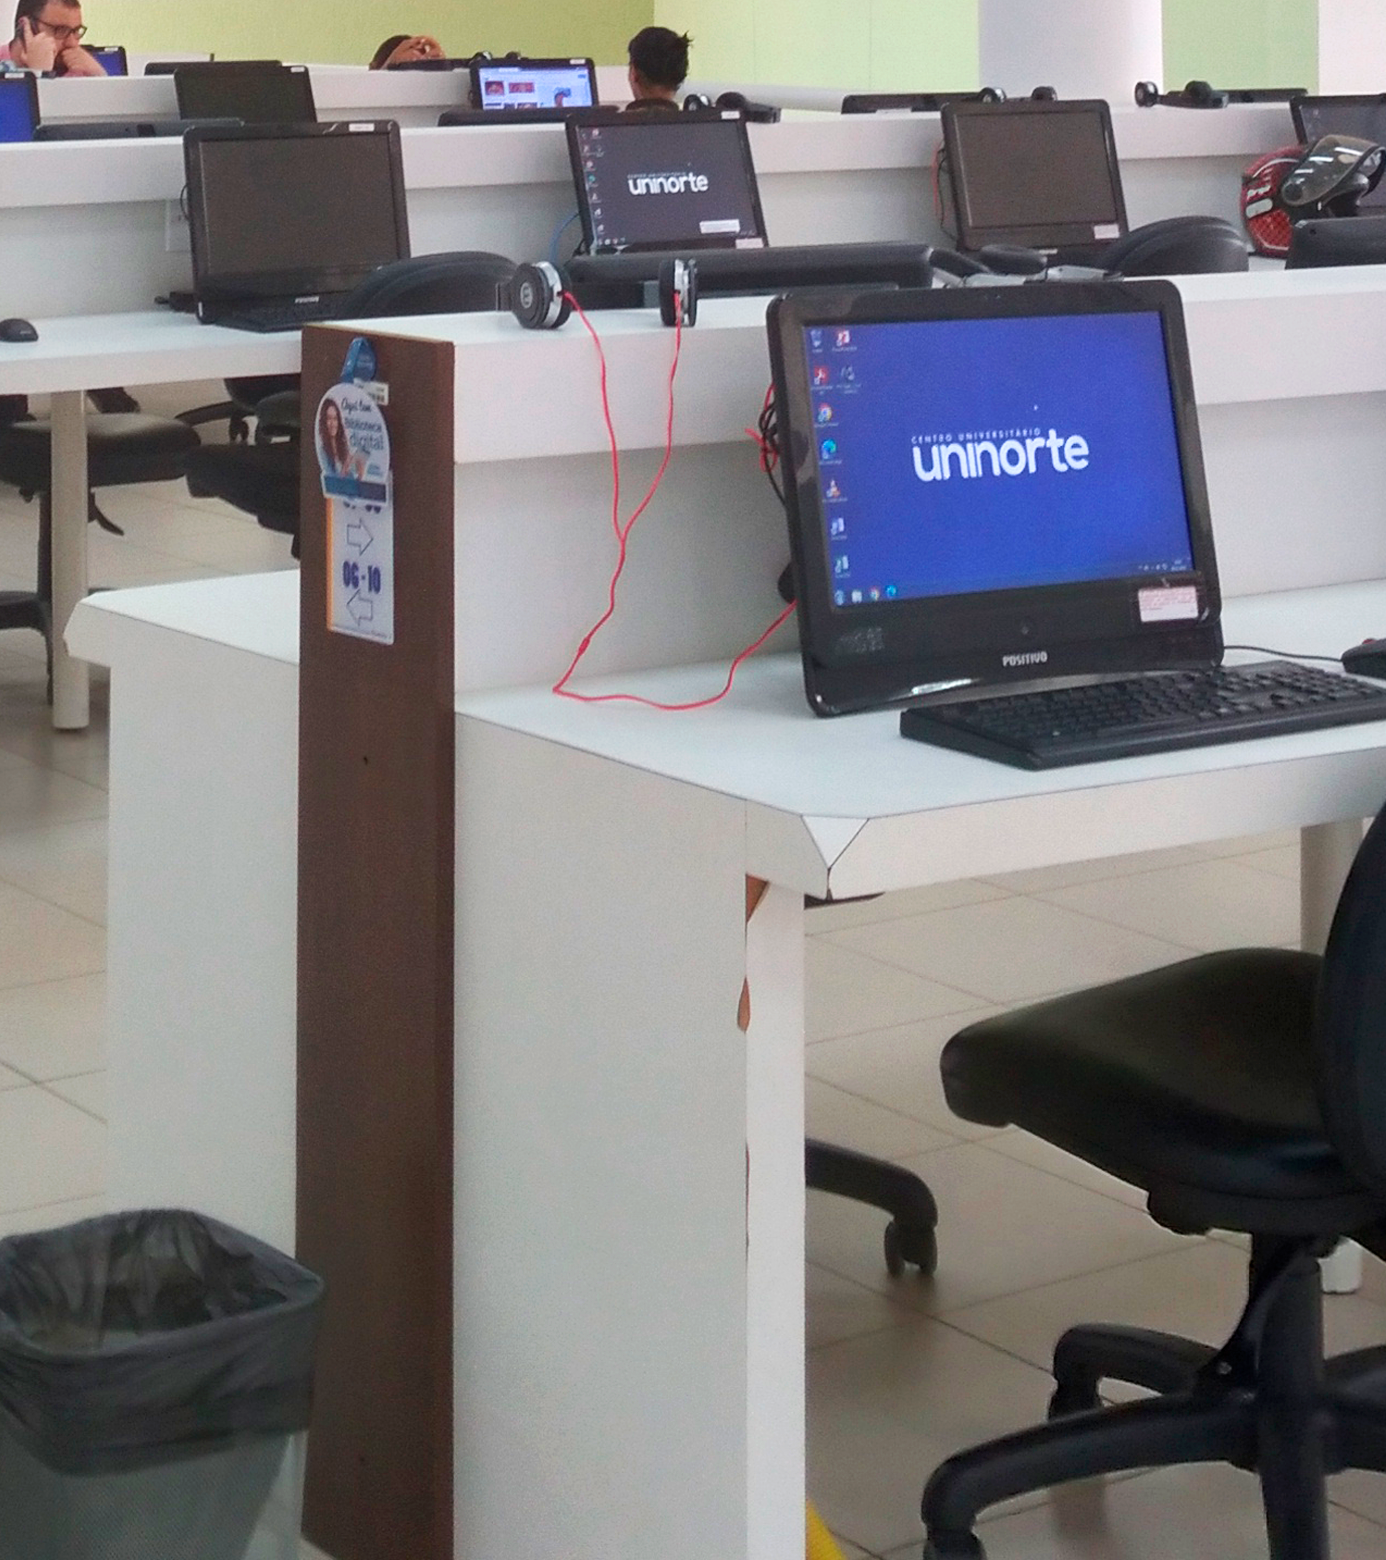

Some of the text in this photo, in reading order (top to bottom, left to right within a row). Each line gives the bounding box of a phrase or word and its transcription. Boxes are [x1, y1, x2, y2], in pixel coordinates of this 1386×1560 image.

[628, 172, 709, 196] uninorte
[911, 433, 953, 445] CENTRO
[912, 428, 1090, 482] uninorte
[1002, 651, 1048, 667] POSITIVO
